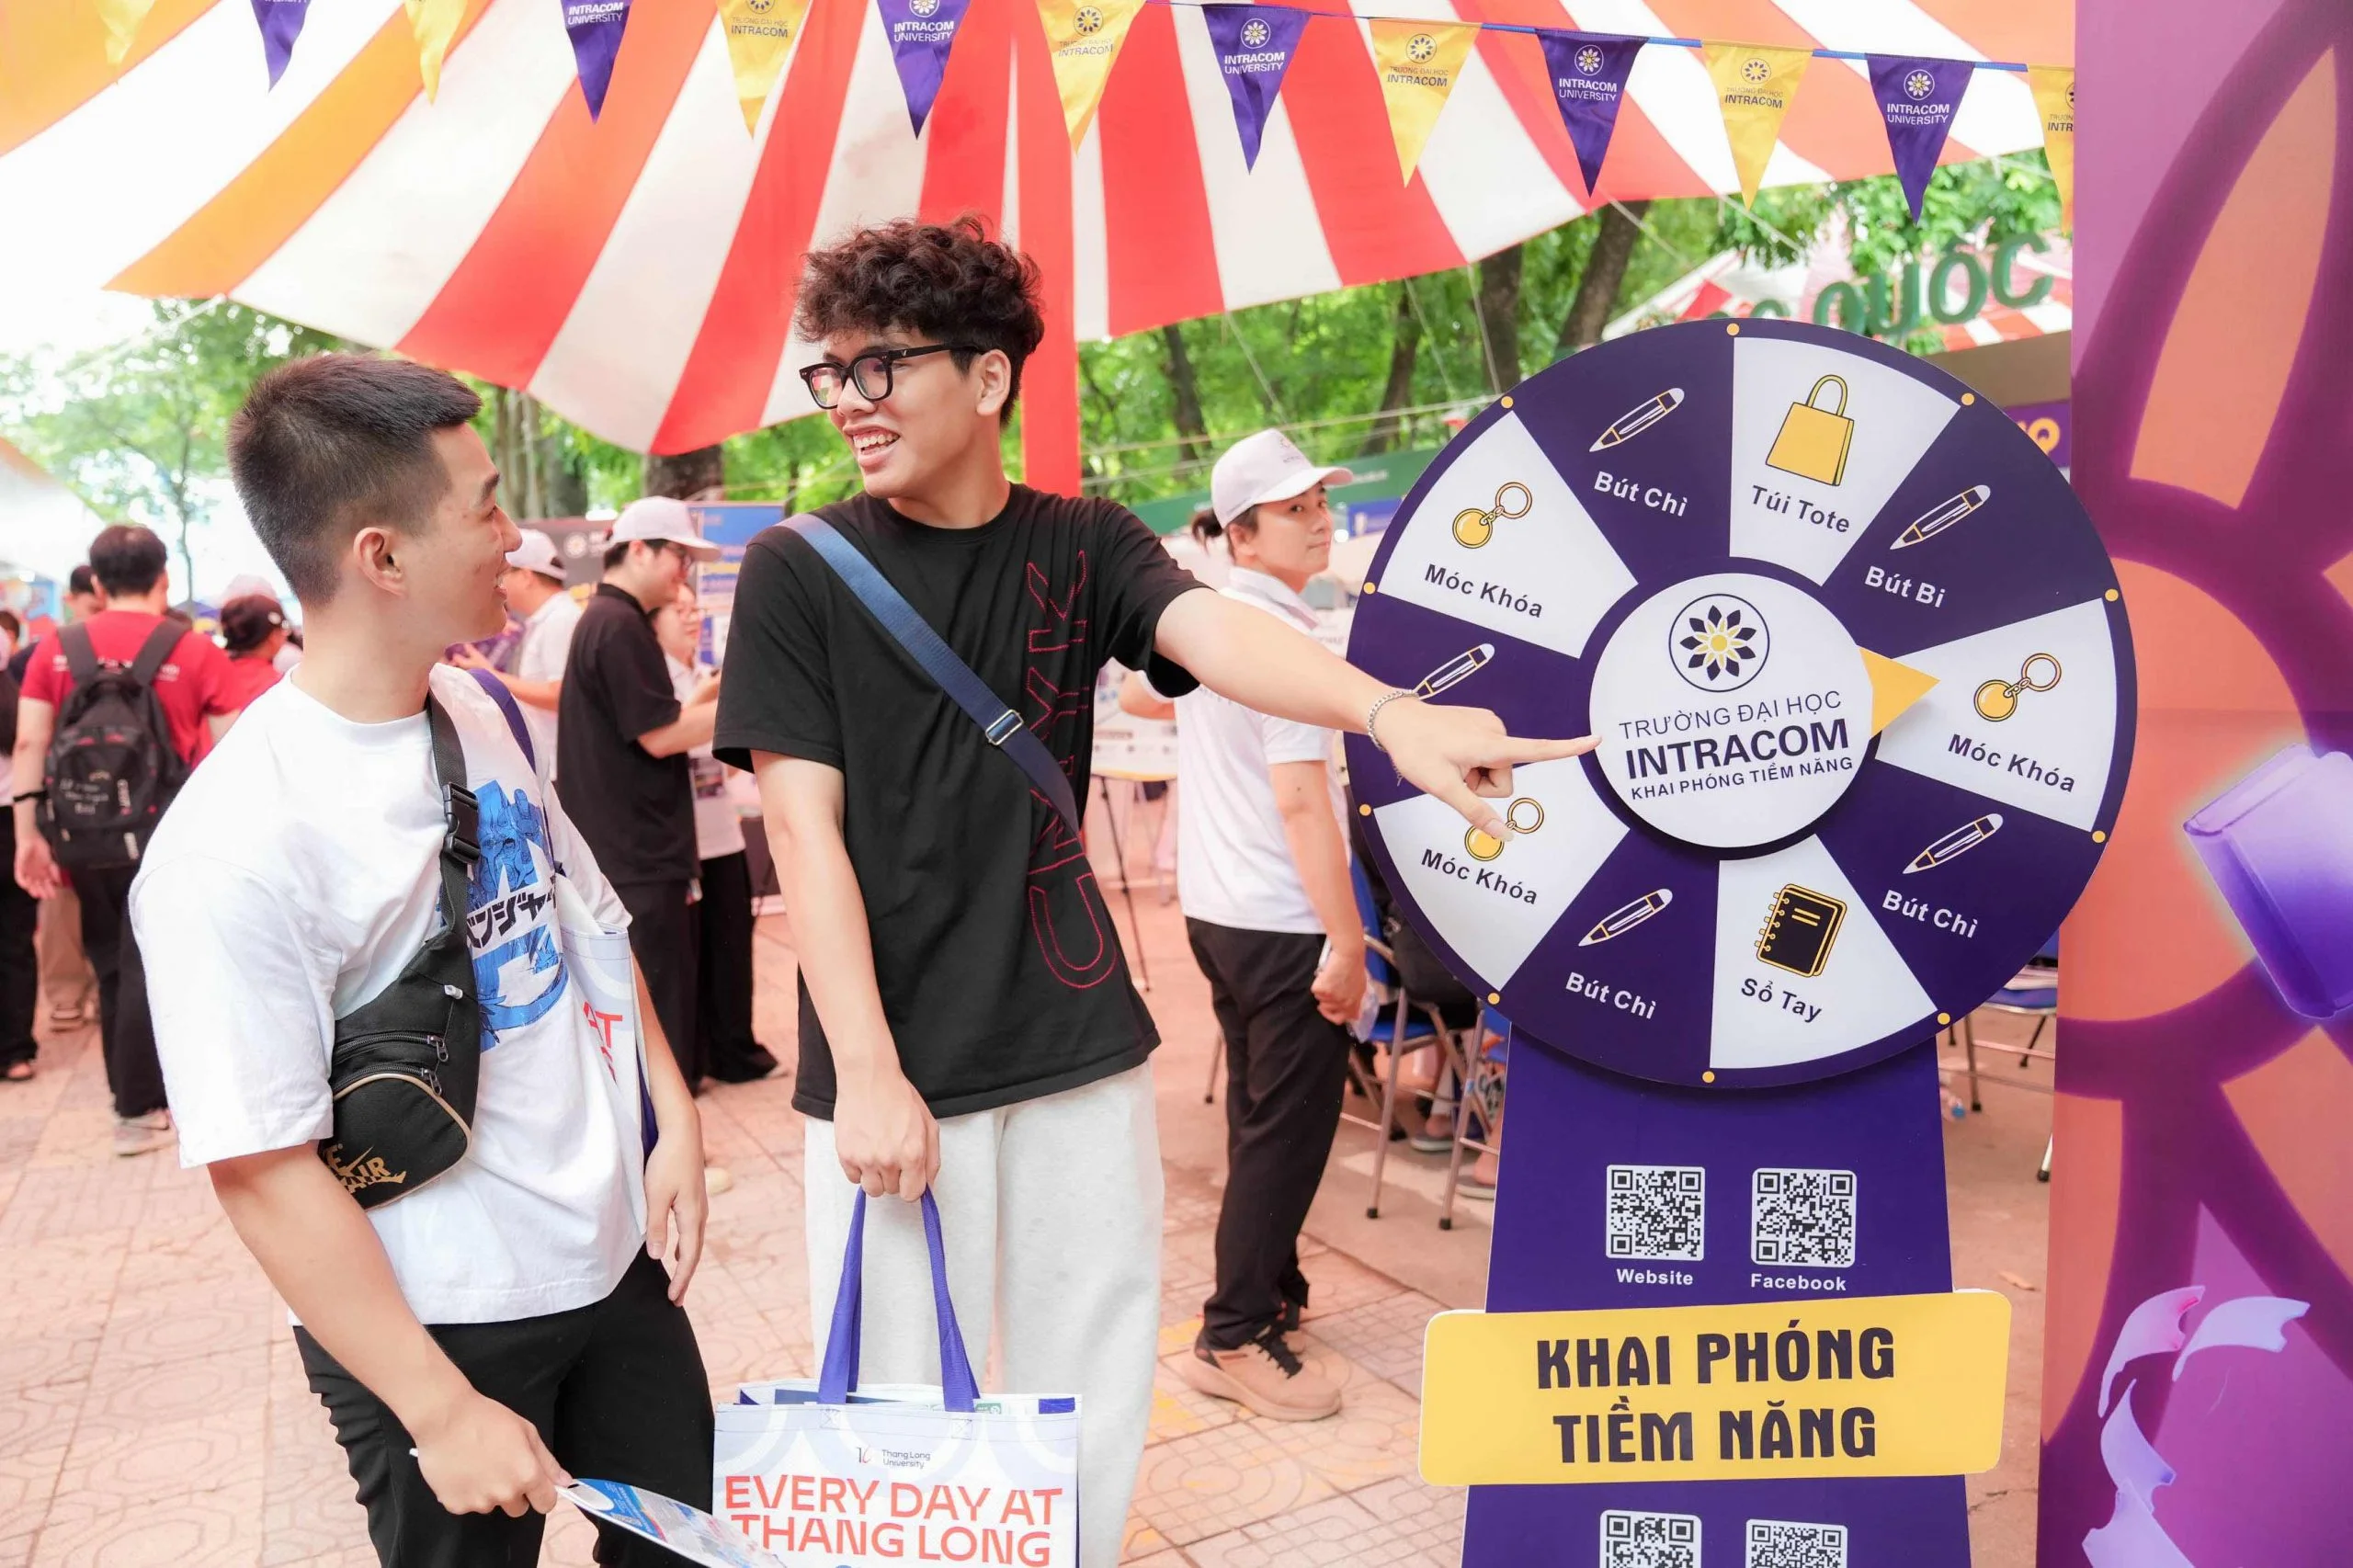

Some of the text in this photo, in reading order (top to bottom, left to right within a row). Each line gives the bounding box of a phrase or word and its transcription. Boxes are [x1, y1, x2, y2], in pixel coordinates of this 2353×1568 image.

[567, 12, 624, 25] UNIVERSITY
[568, 2, 624, 16] INTRACOM
[731, 25, 789, 38] INTRACOM
[893, 21, 955, 33] INTRACOM
[894, 31, 953, 42] UNIVERSITY
[1058, 44, 1114, 57] INTRACOM
[1224, 51, 1286, 64] INTRACOM
[1224, 62, 1284, 74] UNIVERSITY
[1387, 74, 1448, 87] INTRACOM
[1559, 78, 1618, 93] INTRACOM
[1559, 89, 1617, 102] UNIVERSITY
[1725, 95, 1783, 109] INTRACOM
[1887, 103, 1950, 116] INTRACOM
[1887, 114, 1949, 126] UNIVERSITY
[2047, 121, 2075, 132] INTR
[1593, 471, 1688, 517] Bút Chì
[1751, 483, 1851, 535] Túi Tote
[1424, 562, 1544, 619] Móc Khóa
[1863, 564, 1946, 608] Bút Bi
[1619, 690, 1842, 740] TRƯỜNG ĐẠI HỌC
[1625, 718, 1849, 780] INTRACOM
[1947, 733, 2077, 794] Móc Khóa
[1631, 756, 1854, 801] KHAI PHÓNG TIỀM NĂNG
[1420, 846, 1540, 906] Móc Khóa
[1881, 888, 1981, 940] Bút Chì
[1564, 971, 1657, 1021] Bút Chì
[1740, 974, 1824, 1024] Sổ Tay
[1615, 1267, 1847, 1292] Website Facebook
[1536, 1319, 1895, 1390] KHAI PHÓNG
[1552, 1395, 1877, 1464] TIỀM NĂNG
[881, 1449, 909, 1460] Thang
[909, 1451, 931, 1461] Long
[882, 1458, 925, 1470] University
[725, 1474, 1063, 1526] EVERY DAY AT
[731, 1514, 1051, 1568] THANG LONG
